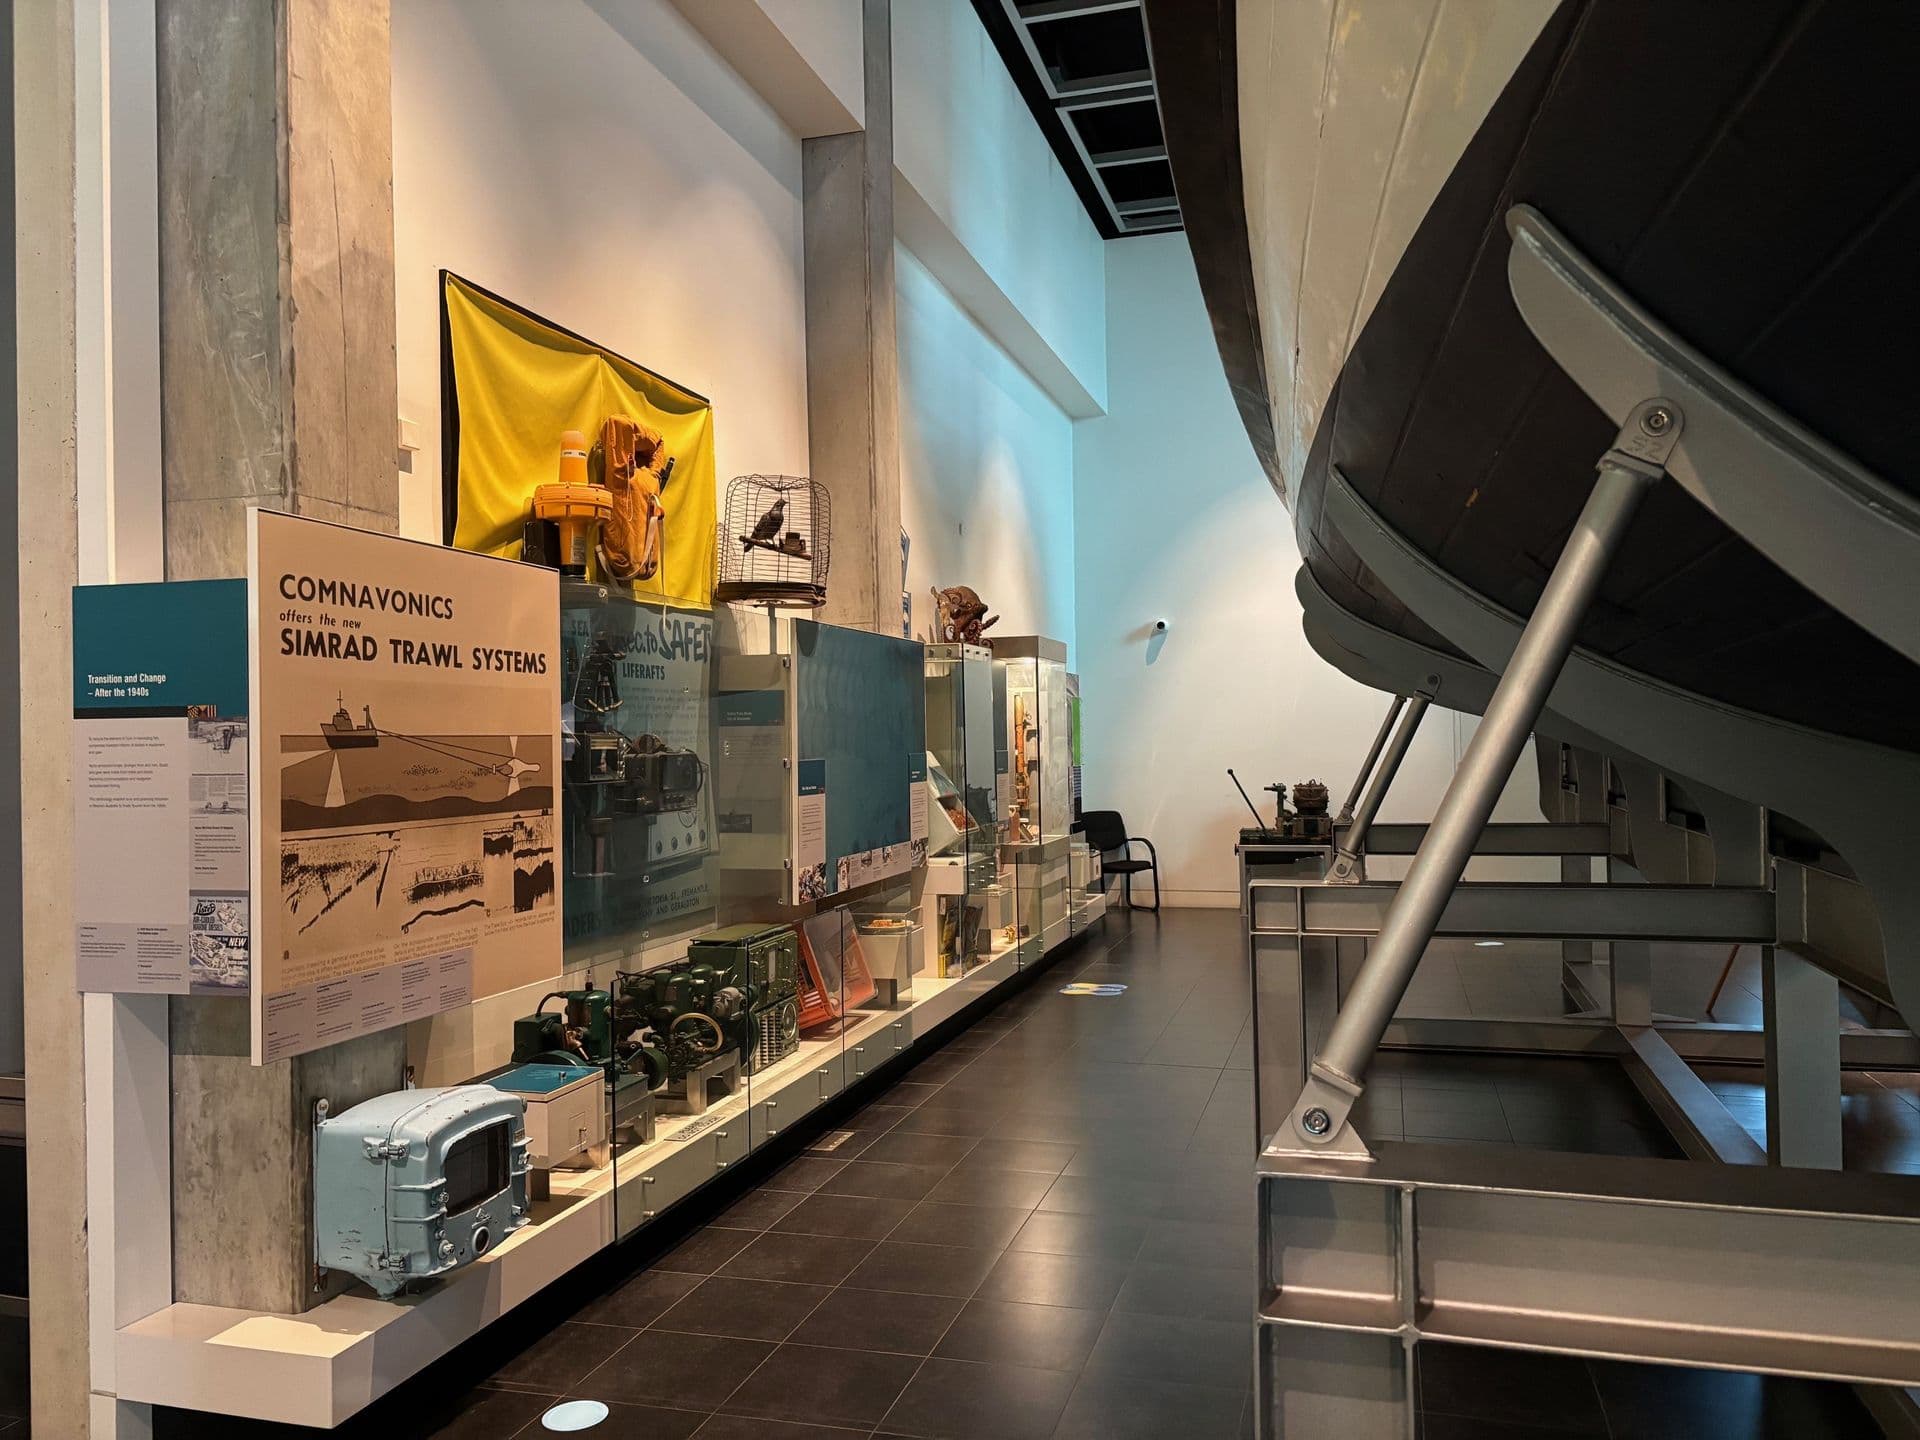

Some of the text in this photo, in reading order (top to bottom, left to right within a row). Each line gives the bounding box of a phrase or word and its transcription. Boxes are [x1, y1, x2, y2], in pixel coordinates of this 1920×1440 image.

[279, 574, 453, 619] COMNAVONICS
[279, 609, 361, 630] offers the new
[280, 627, 546, 674] SIMRAD TRAWL SYSTEMS
[87, 673, 166, 684] Transition and Change
[622, 662, 666, 680] LIFERAFTS
[94, 688, 112, 697] After
[114, 687, 125, 697] the
[127, 687, 149, 697] 1940s
[228, 937, 247, 947] NEW
